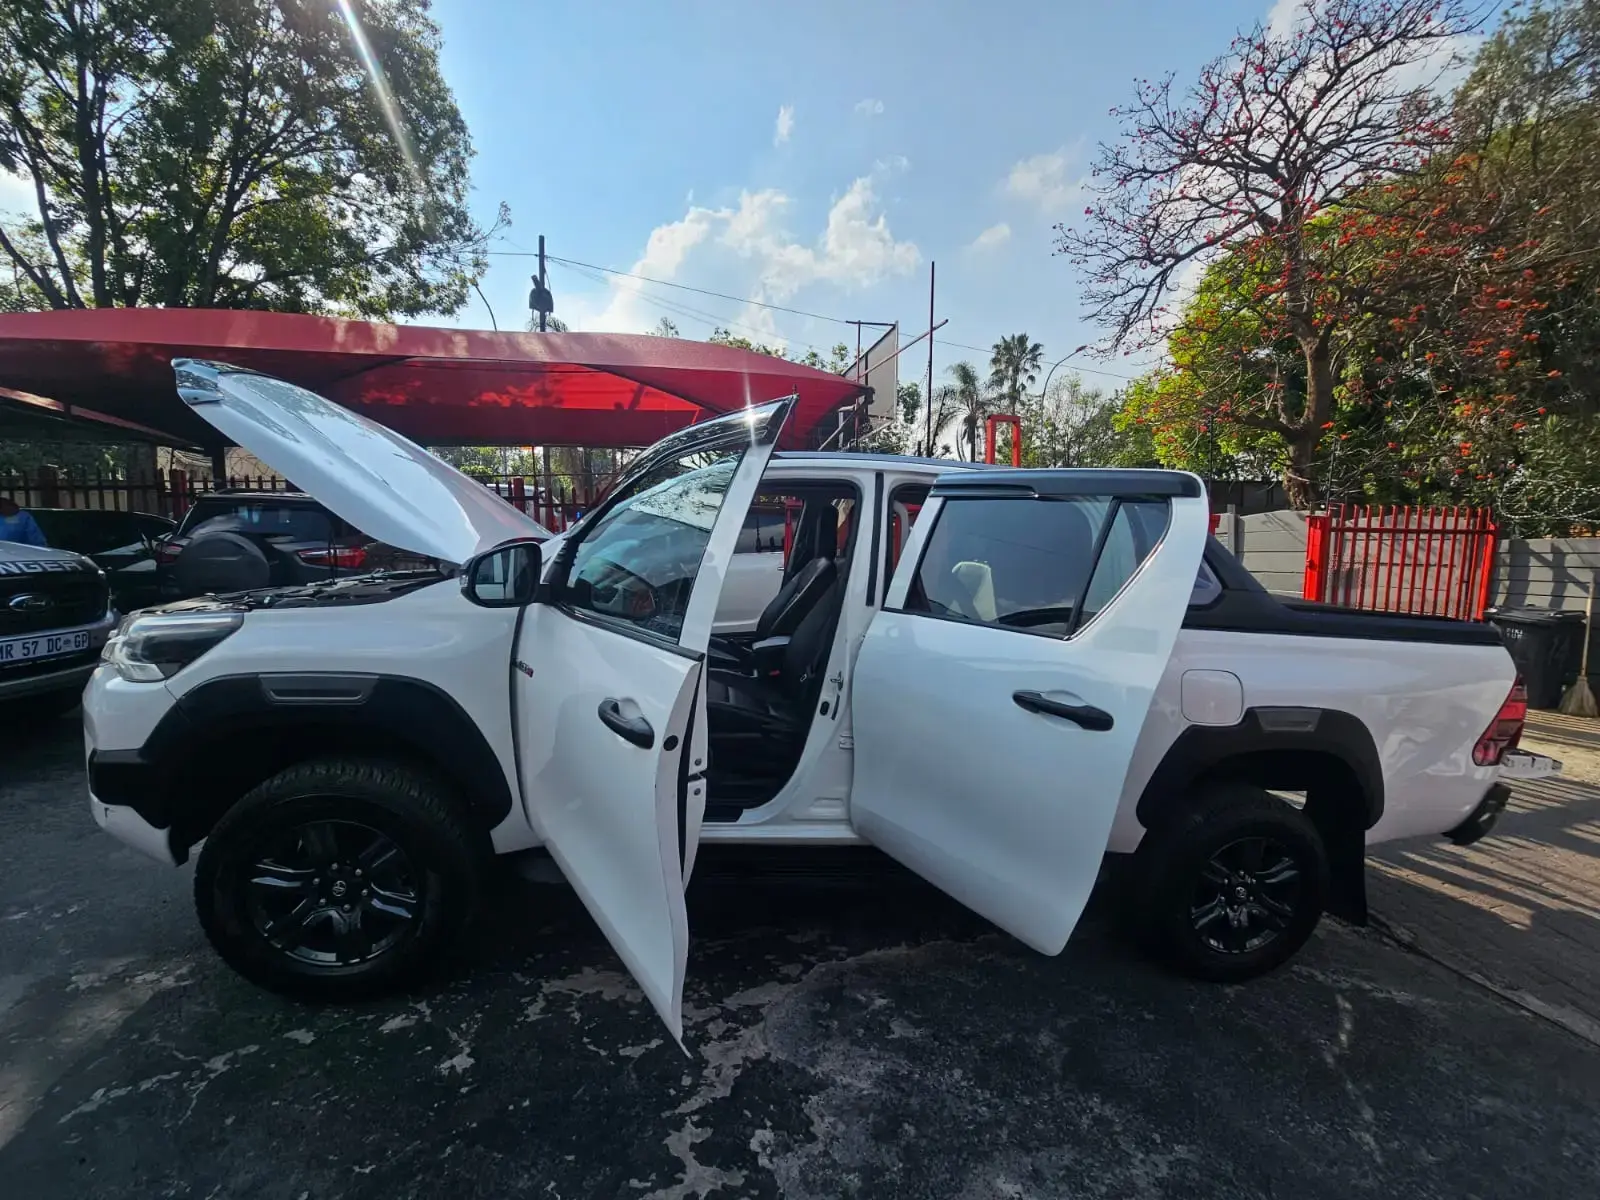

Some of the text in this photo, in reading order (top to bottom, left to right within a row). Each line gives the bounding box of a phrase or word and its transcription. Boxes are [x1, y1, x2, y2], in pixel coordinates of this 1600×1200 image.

[22, 640, 39, 657] 57
[47, 637, 62, 653] DC
[74, 633, 88, 649] GP
